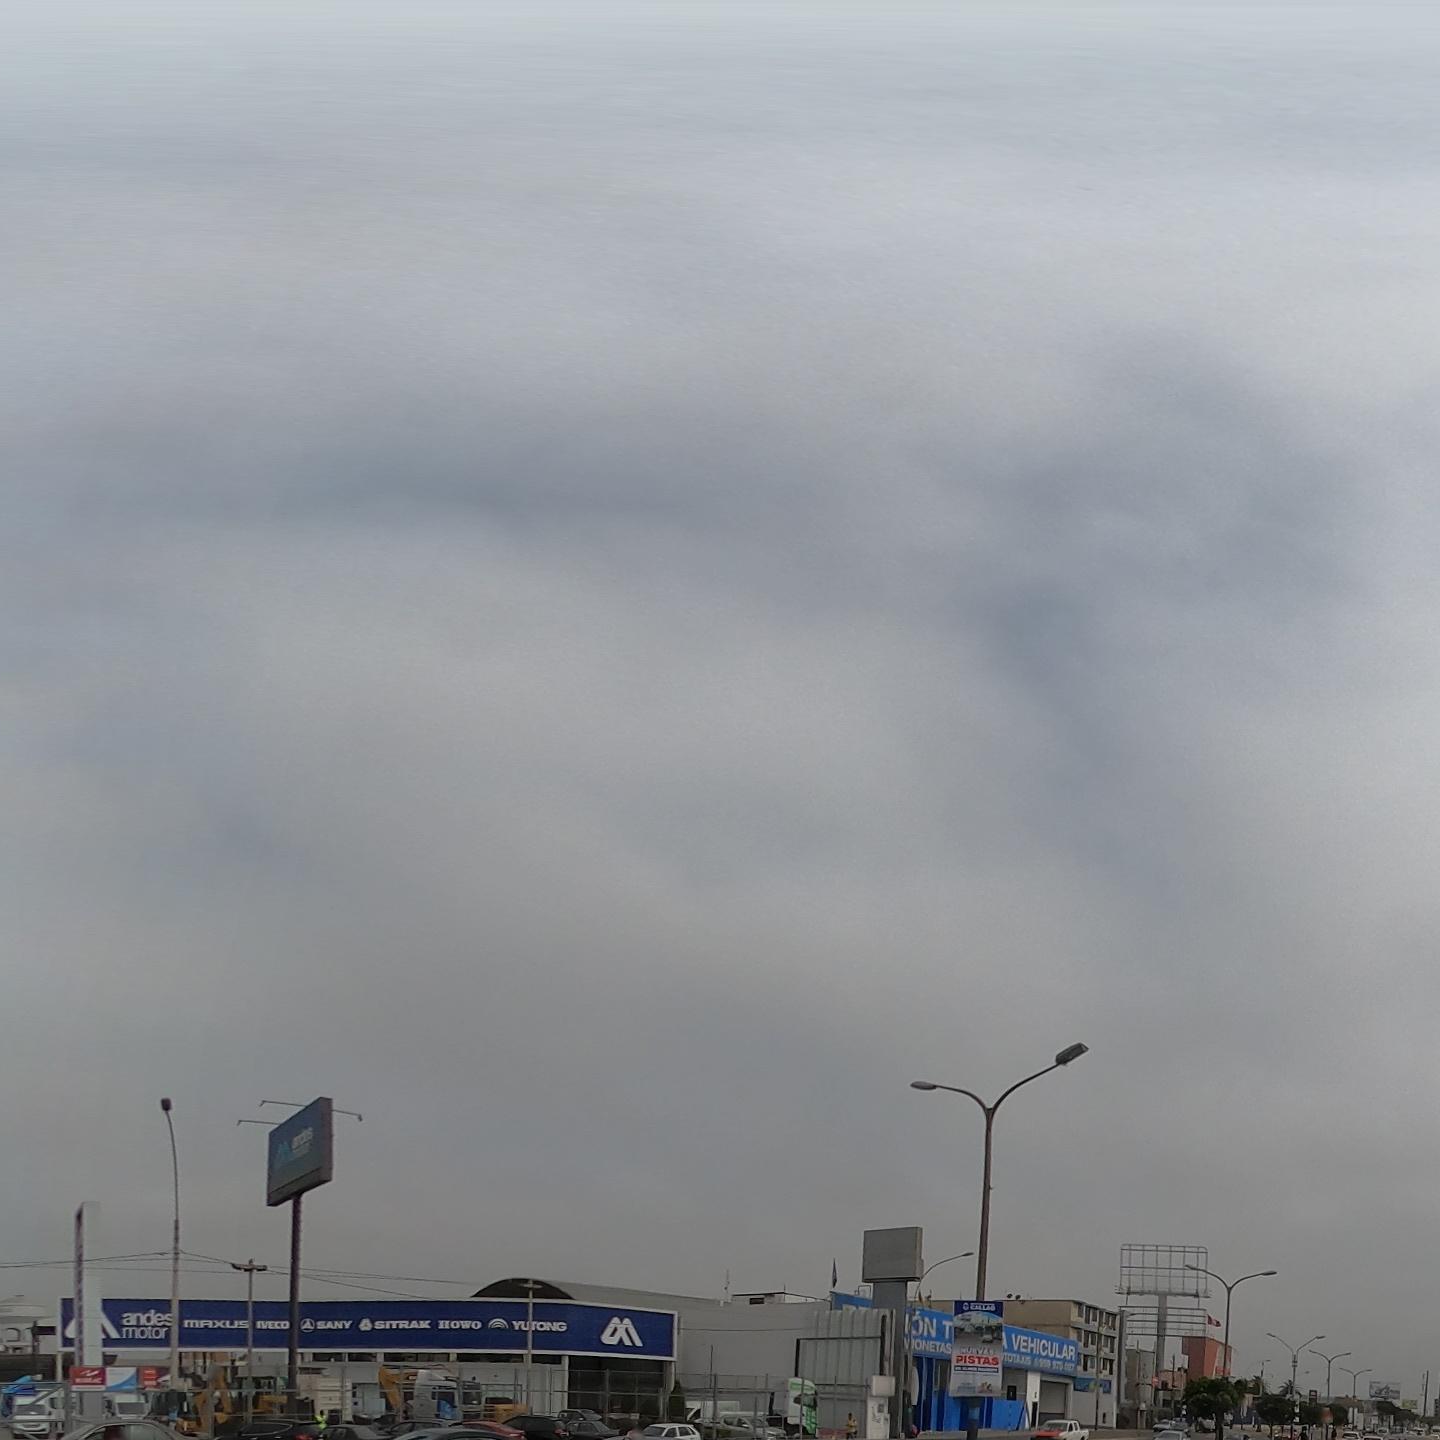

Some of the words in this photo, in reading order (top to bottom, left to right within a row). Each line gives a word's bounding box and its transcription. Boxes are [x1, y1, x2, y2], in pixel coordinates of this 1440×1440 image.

[121, 1309, 173, 1327] andes
[183, 1319, 249, 1329] MAXUS
[256, 1320, 289, 1329] IVECO
[316, 1320, 352, 1330] SANY
[373, 1320, 431, 1330] SITRAK
[437, 1320, 482, 1330] HOWO
[512, 1320, 568, 1332] YUTONG
[121, 1325, 169, 1339] motor
[1011, 1333, 1076, 1362] VEHICULAR
[955, 1355, 999, 1365] PISTAS
